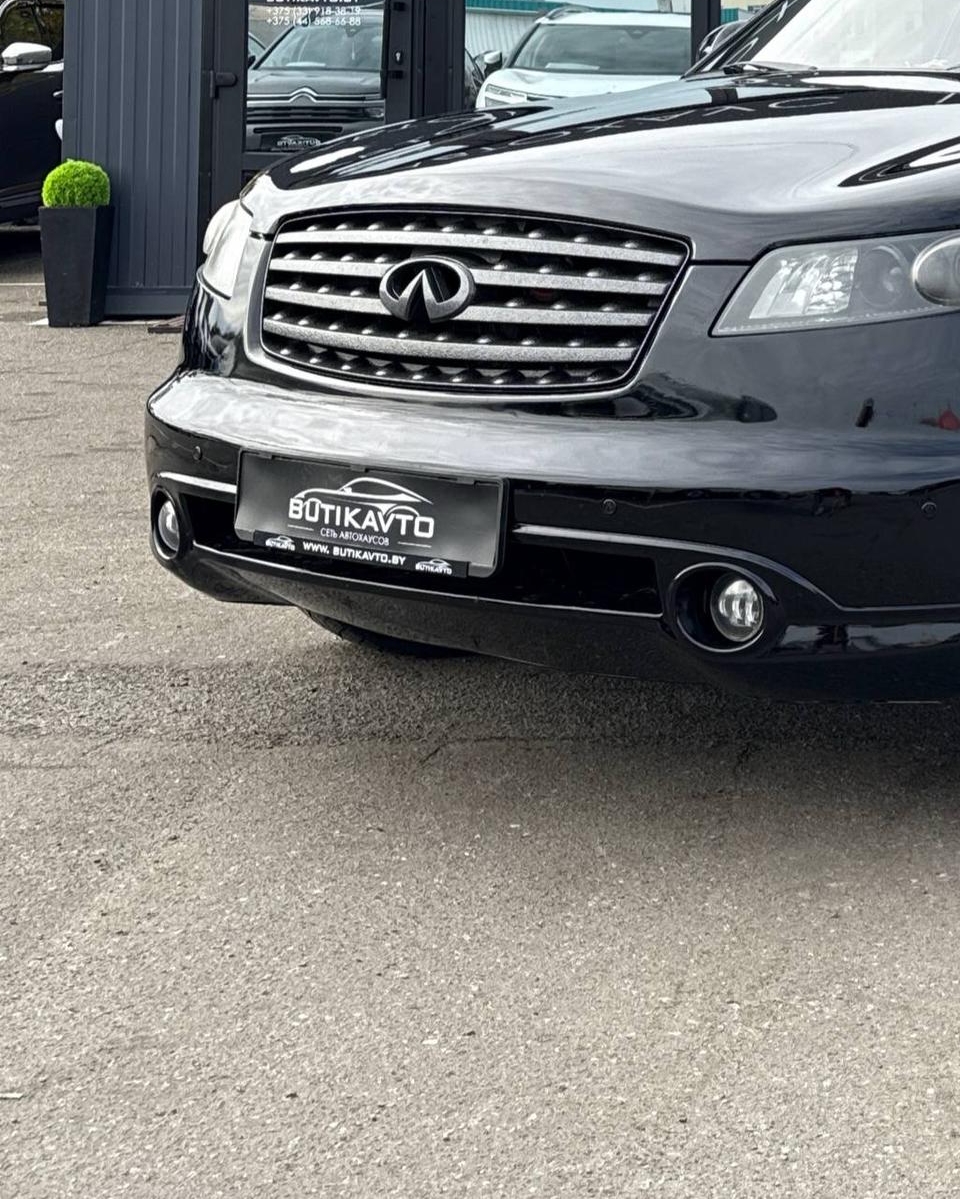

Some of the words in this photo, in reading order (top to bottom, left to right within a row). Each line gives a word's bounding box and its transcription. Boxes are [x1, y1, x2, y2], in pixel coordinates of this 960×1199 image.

[266, 16, 290, 25] +375
[288, 498, 435, 538] BUTIKAVTO
[320, 527, 338, 539] СЕТЬ
[339, 531, 390, 546] АВТОХАУСОВ
[302, 541, 330, 554] WWW.
[333, 546, 406, 566] BUTIKAVTO.BY
